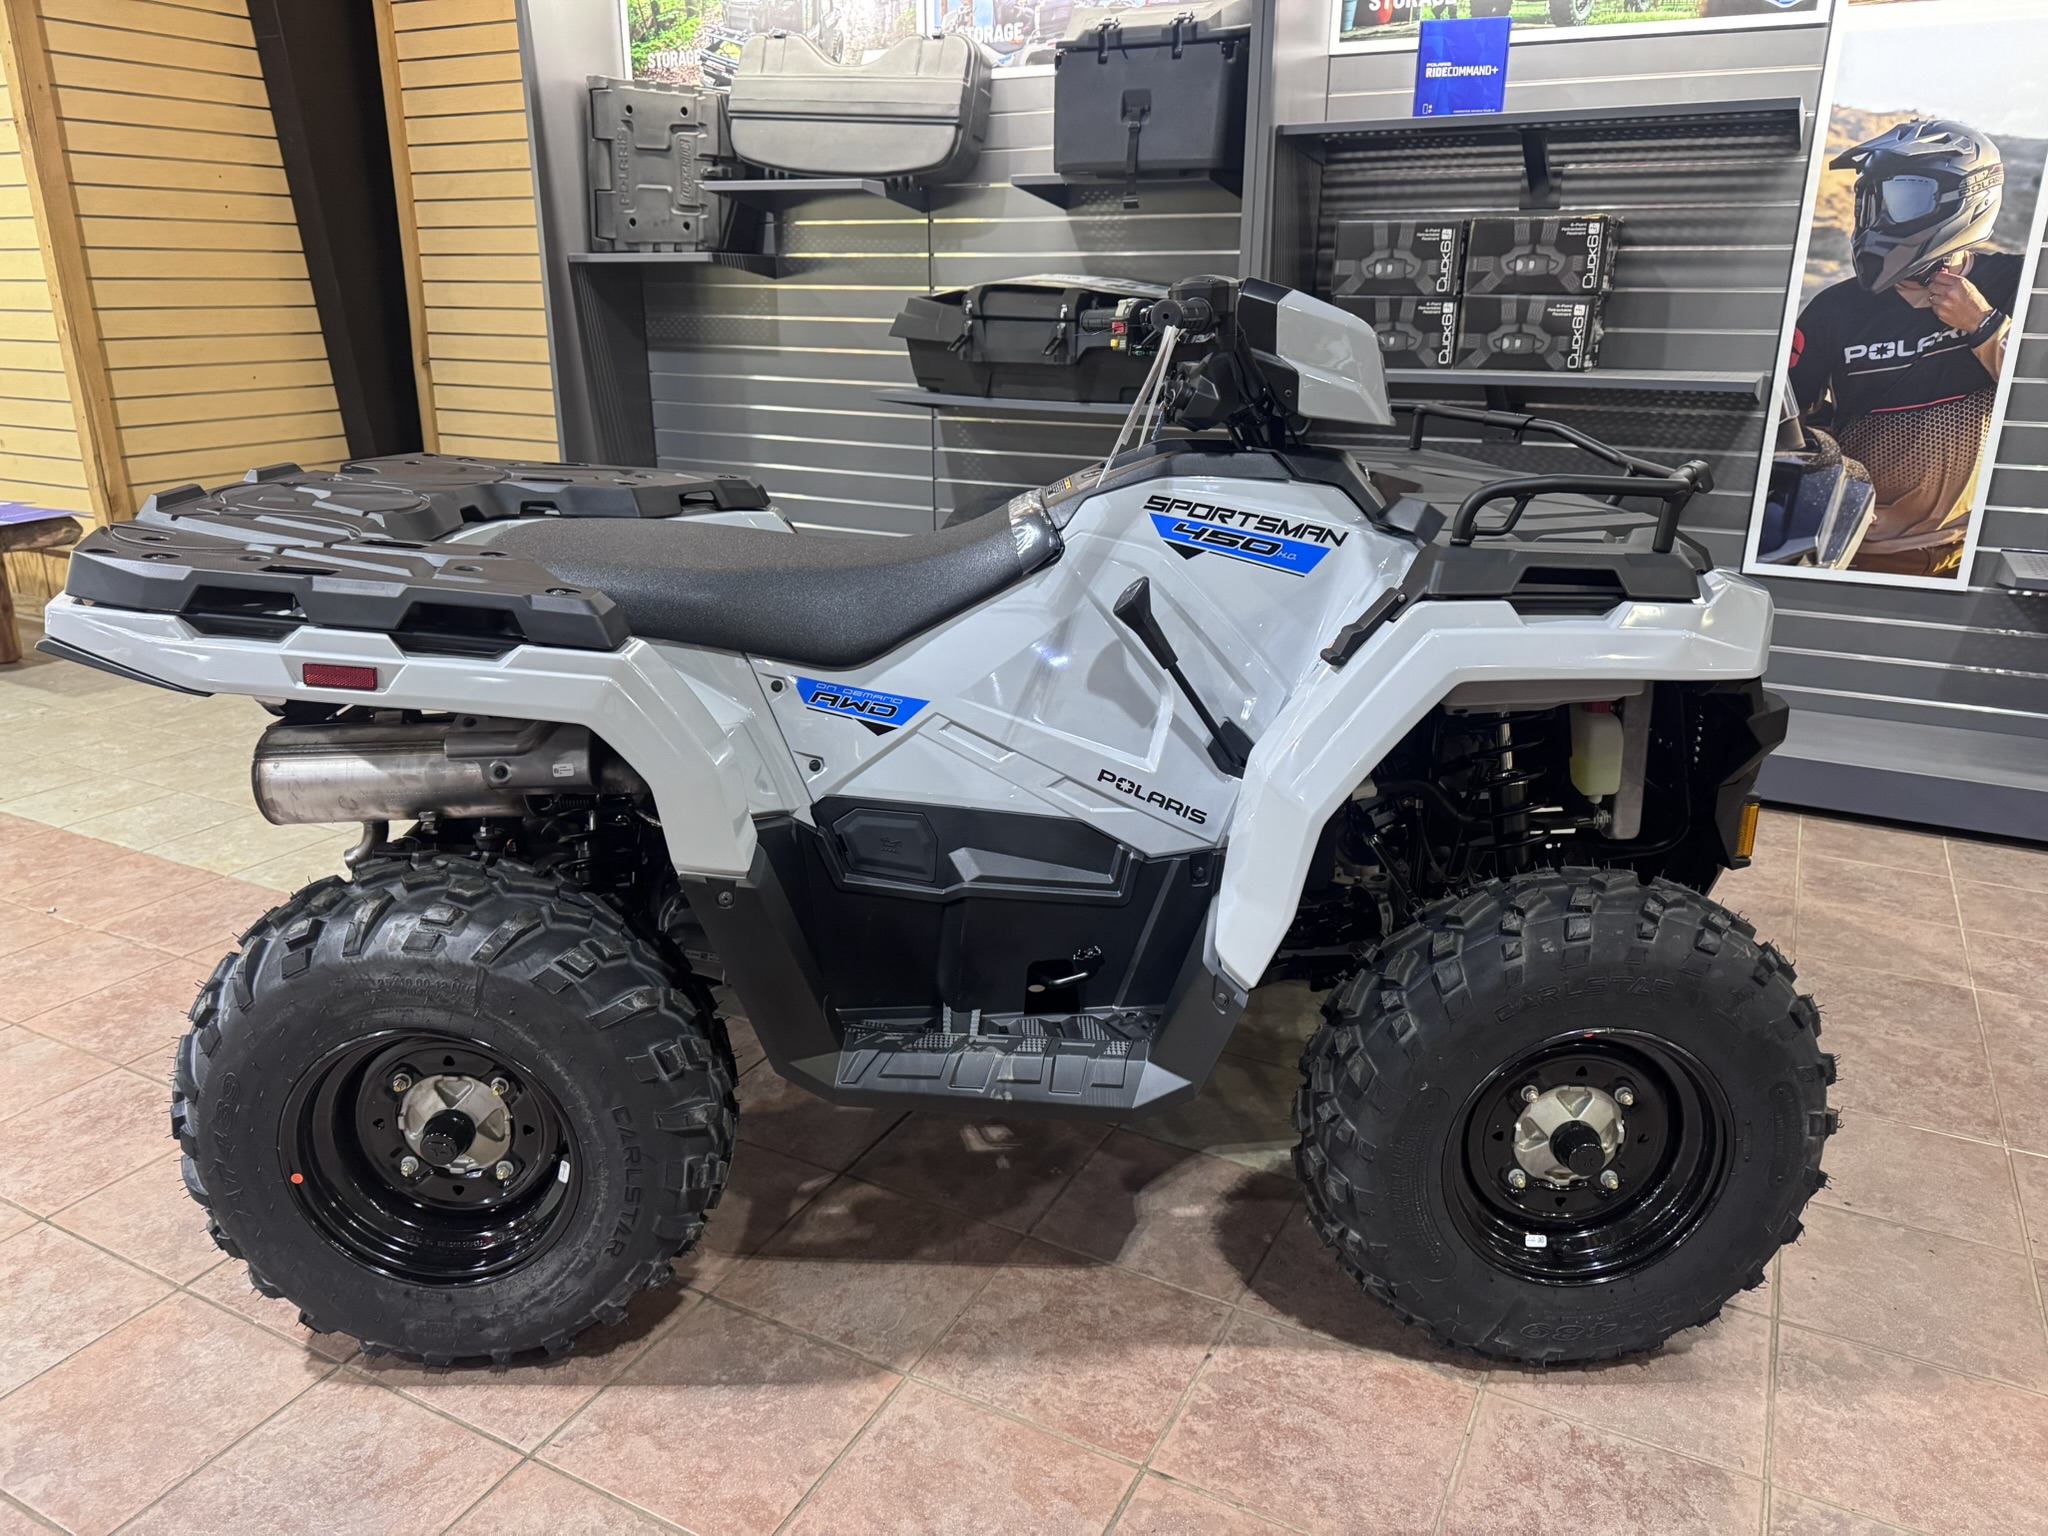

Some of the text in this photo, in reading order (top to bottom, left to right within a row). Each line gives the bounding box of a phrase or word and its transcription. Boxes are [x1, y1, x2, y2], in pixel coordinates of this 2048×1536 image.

[647, 49, 701, 69] STORAGE
[1143, 495, 1349, 547] SPORTSMAN
[1172, 522, 1283, 558] 450
[808, 690, 899, 719] AWD
[816, 683, 903, 704] ON DEMAND
[1097, 769, 1208, 825] POLARIS
[1494, 976, 1676, 1025] CARLSTAR
[604, 1104, 643, 1257] CARLSTAR
